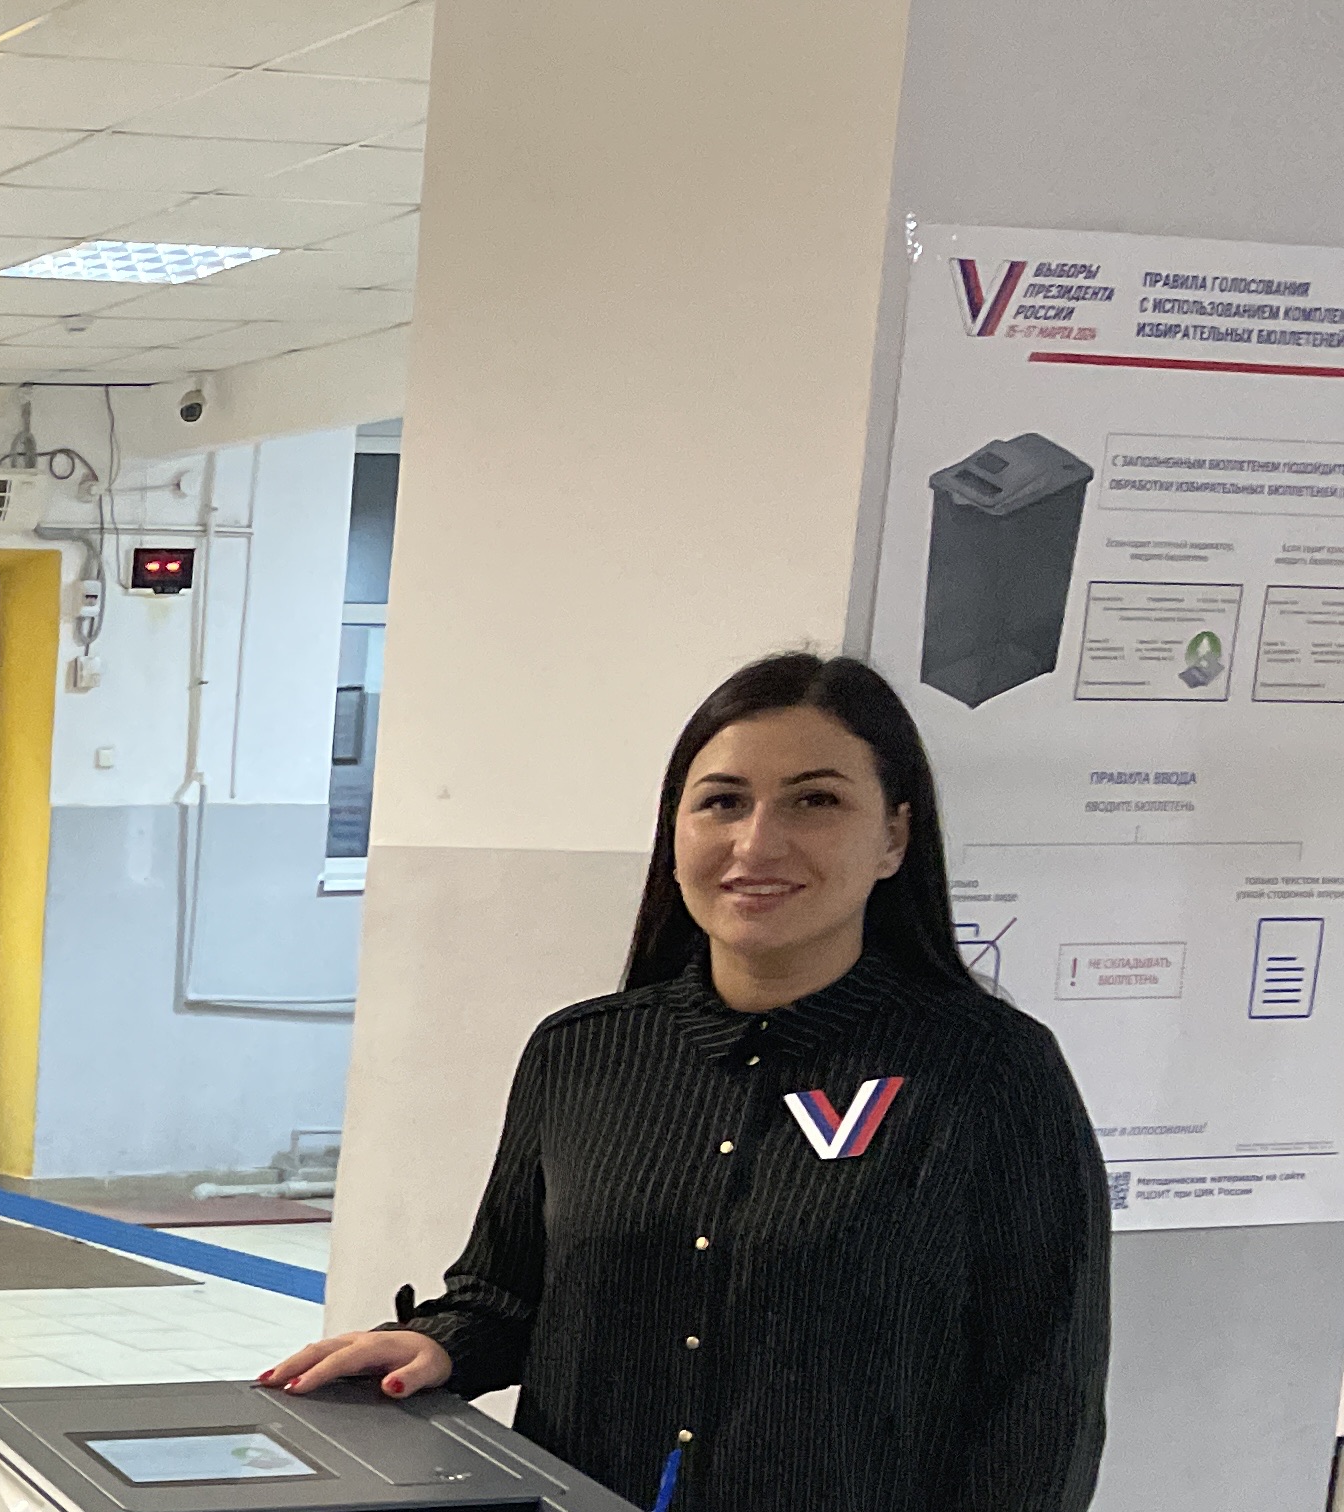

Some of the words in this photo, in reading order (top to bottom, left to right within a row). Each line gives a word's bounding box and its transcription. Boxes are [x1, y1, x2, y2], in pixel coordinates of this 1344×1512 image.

[1032, 262, 1101, 280] ВЫБОРЫ
[1023, 282, 1116, 302] ПРЕЗИДЕНТА
[1143, 271, 1207, 291] ПРАВИЛА
[1211, 276, 1311, 297] ГОЛОСОВАНИЯ
[1013, 304, 1076, 321] РОССИИ
[1139, 297, 1150, 313] С
[1152, 298, 1281, 320] ИСПОЛЬЗОВАНИЕМ
[1136, 322, 1254, 343] ИЗБИРАТЕЛЬНЫХ
[1090, 771, 1150, 785] ПРАВИЛА
[1153, 771, 1197, 786] ВВОДА
